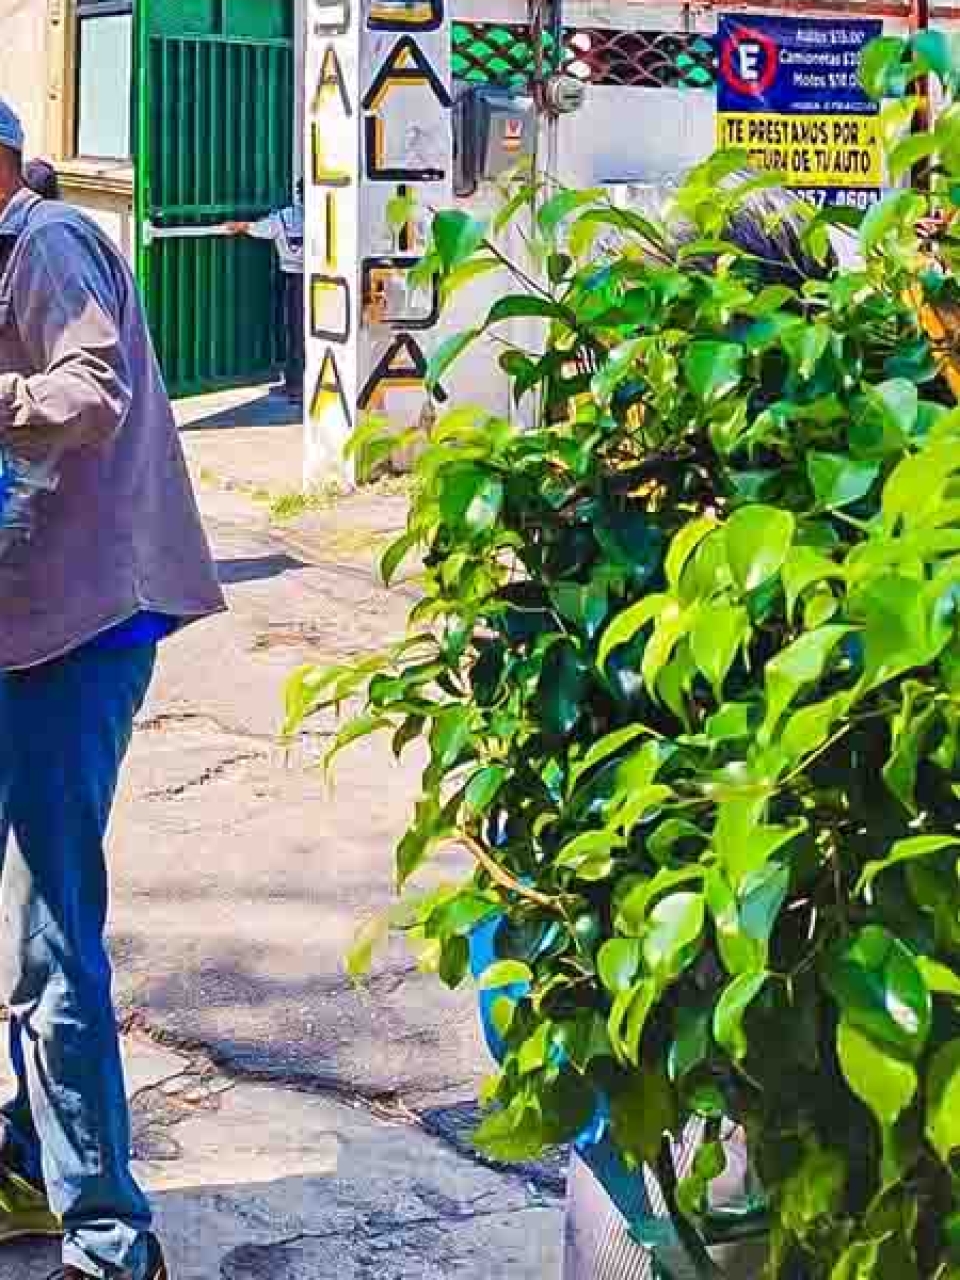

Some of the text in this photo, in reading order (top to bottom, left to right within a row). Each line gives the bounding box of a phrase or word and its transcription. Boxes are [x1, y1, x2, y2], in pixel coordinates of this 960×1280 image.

[739, 43, 760, 81] E
[727, 119, 743, 143] TE
[748, 120, 828, 144] PRESTAMOS
[833, 121, 859, 144] POR
[833, 150, 871, 175] AUTO
